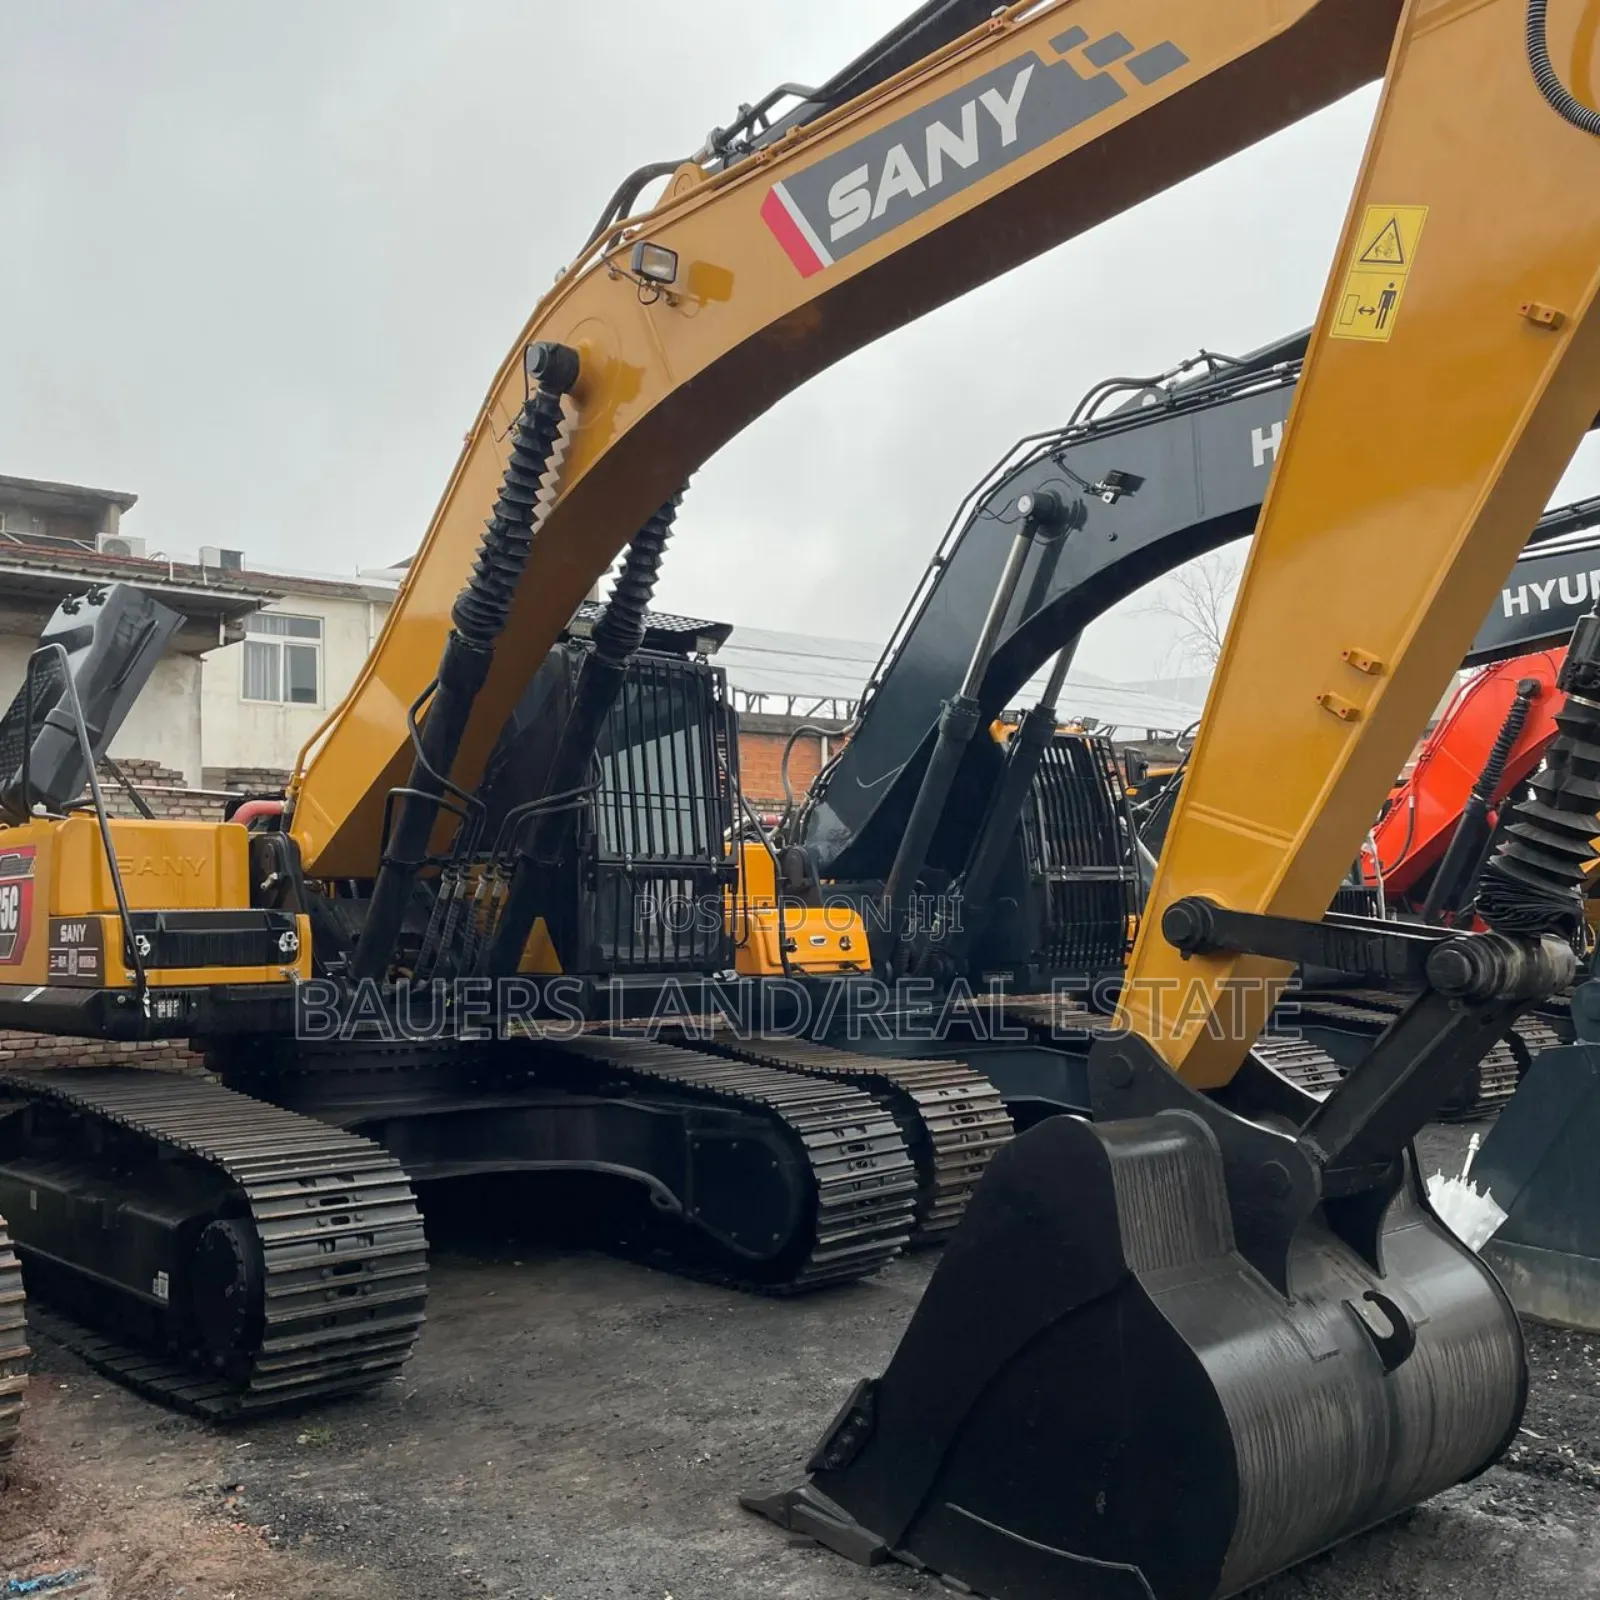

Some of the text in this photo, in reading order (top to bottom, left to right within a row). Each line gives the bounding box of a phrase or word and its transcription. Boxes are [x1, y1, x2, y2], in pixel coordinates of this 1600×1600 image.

[827, 63, 1035, 243] SANY
[1251, 420, 1287, 468] H
[0, 884, 19, 931] 5C
[60, 923, 87, 943] SANY
